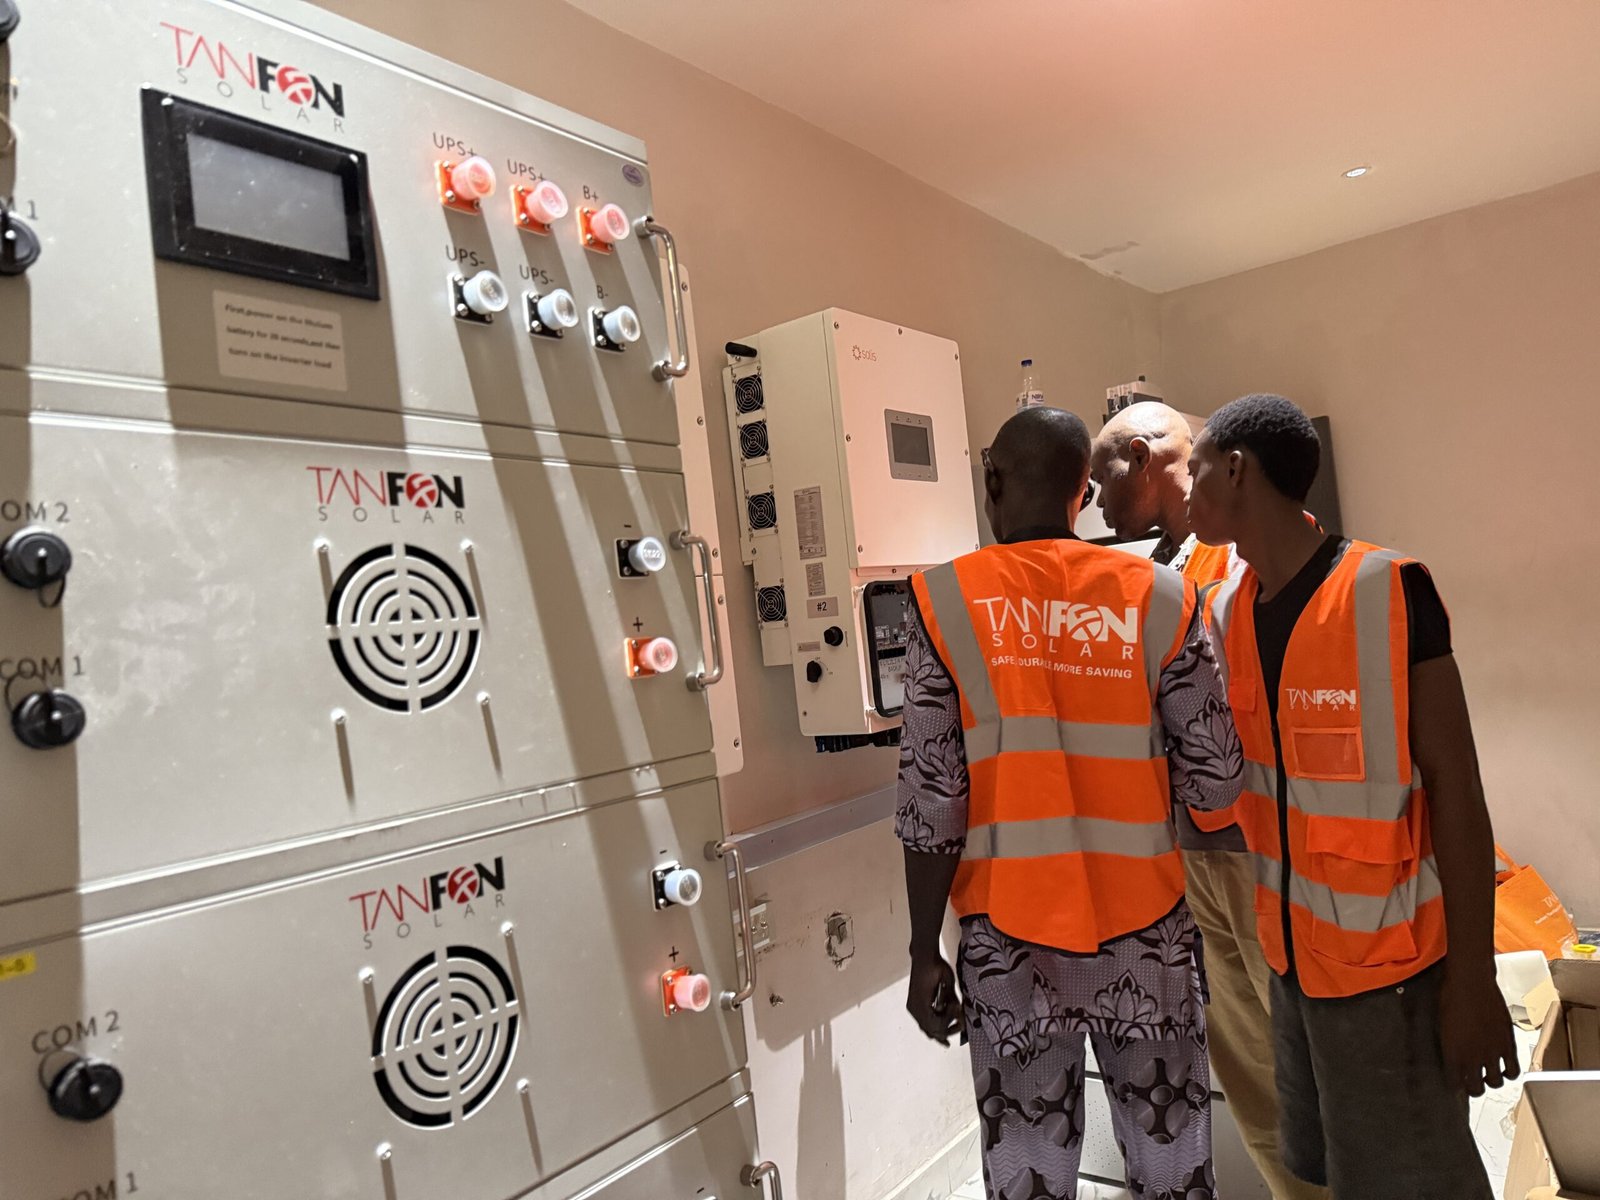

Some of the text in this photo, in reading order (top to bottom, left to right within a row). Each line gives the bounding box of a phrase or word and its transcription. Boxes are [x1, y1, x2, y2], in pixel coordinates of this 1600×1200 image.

[160, 22, 345, 118] TANFON
[177, 68, 345, 133] SOLAR
[433, 132, 477, 157] UPS+
[507, 159, 546, 182] UPS+
[583, 185, 598, 202] B+
[445, 245, 485, 267] UPS-
[520, 265, 554, 284] UPS-
[597, 285, 608, 300] B-
[226, 326, 254, 339] battery
[306, 466, 466, 509] TANFON
[0, 502, 70, 523] OM 2
[318, 507, 466, 525] SOLAR
[817, 601, 827, 612] #2
[973, 596, 1139, 644] TANFON
[992, 632, 1134, 660] SOLAR
[0, 656, 85, 680] COM 1
[1053, 662, 1083, 675] MORE
[1086, 666, 1133, 679] SAVING
[1285, 688, 1357, 705] TANFON
[1290, 703, 1356, 712] SOLAR
[349, 856, 506, 932] TANFON
[362, 895, 506, 950] SOLAR
[32, 1010, 120, 1055] COM 2
[126, 1172, 138, 1194] 1
